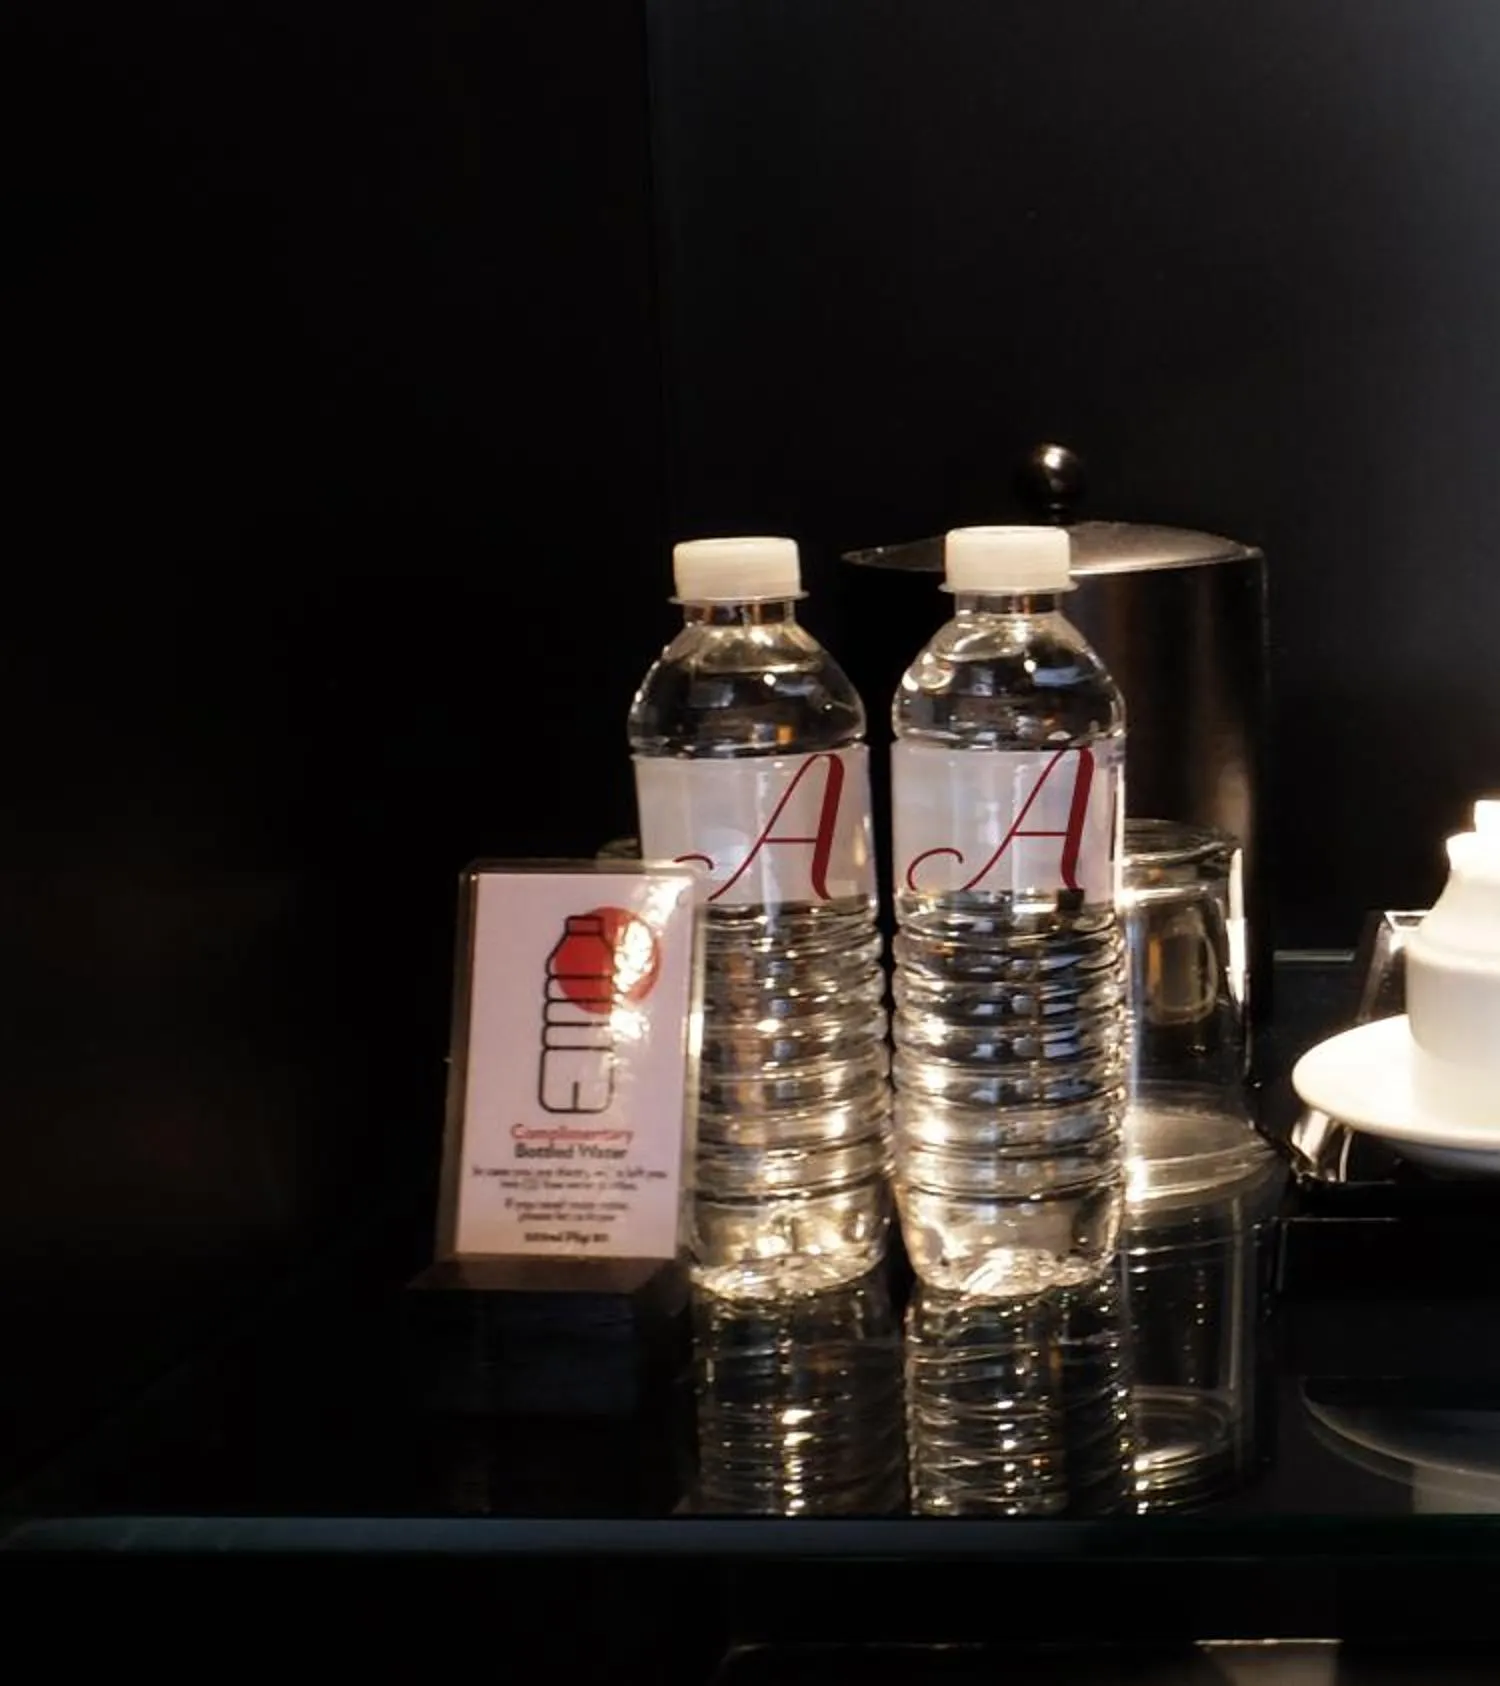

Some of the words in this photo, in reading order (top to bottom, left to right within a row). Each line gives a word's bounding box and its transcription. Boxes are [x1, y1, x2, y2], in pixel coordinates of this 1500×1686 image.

[674, 752, 846, 902] A
[906, 746, 1096, 892] A
[511, 1123, 634, 1145] Complimentary
[514, 1142, 574, 1159] Bottled
[577, 1143, 629, 1159] Water
